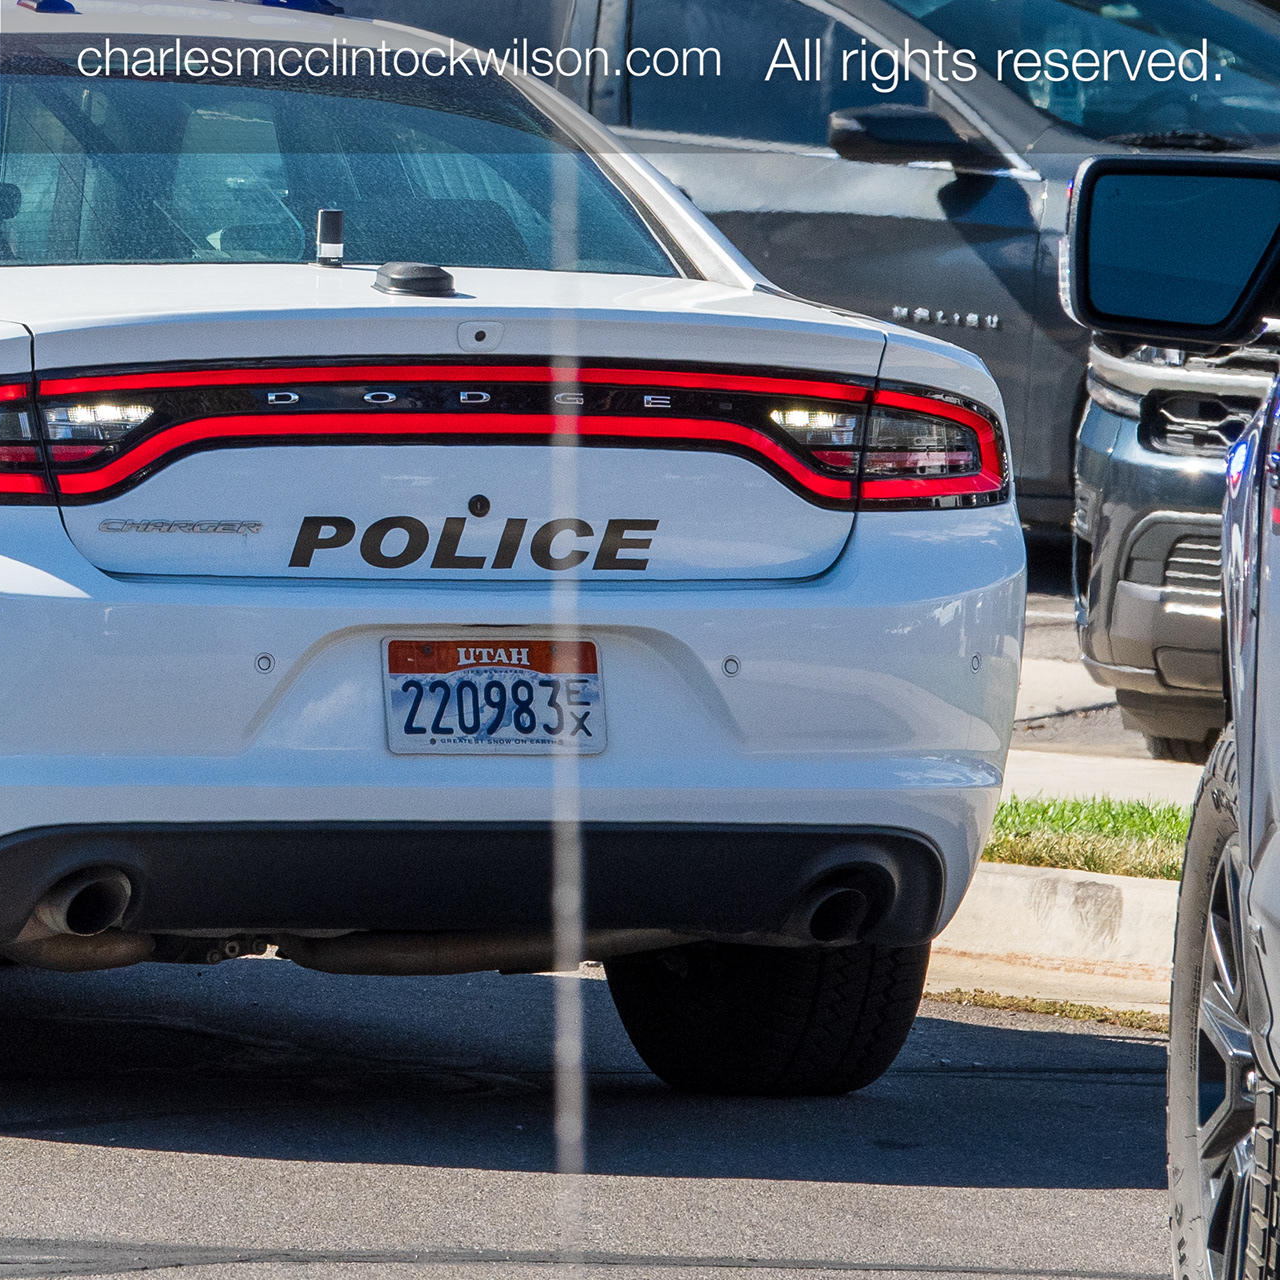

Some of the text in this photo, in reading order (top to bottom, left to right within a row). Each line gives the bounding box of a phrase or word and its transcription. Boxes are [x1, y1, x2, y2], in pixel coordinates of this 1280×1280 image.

[267, 391, 672, 408] DODGE
[98, 519, 264, 534] CHARGER
[288, 516, 661, 571] POLICE
[456, 647, 530, 666] UTAH
[401, 680, 564, 735] 220983
